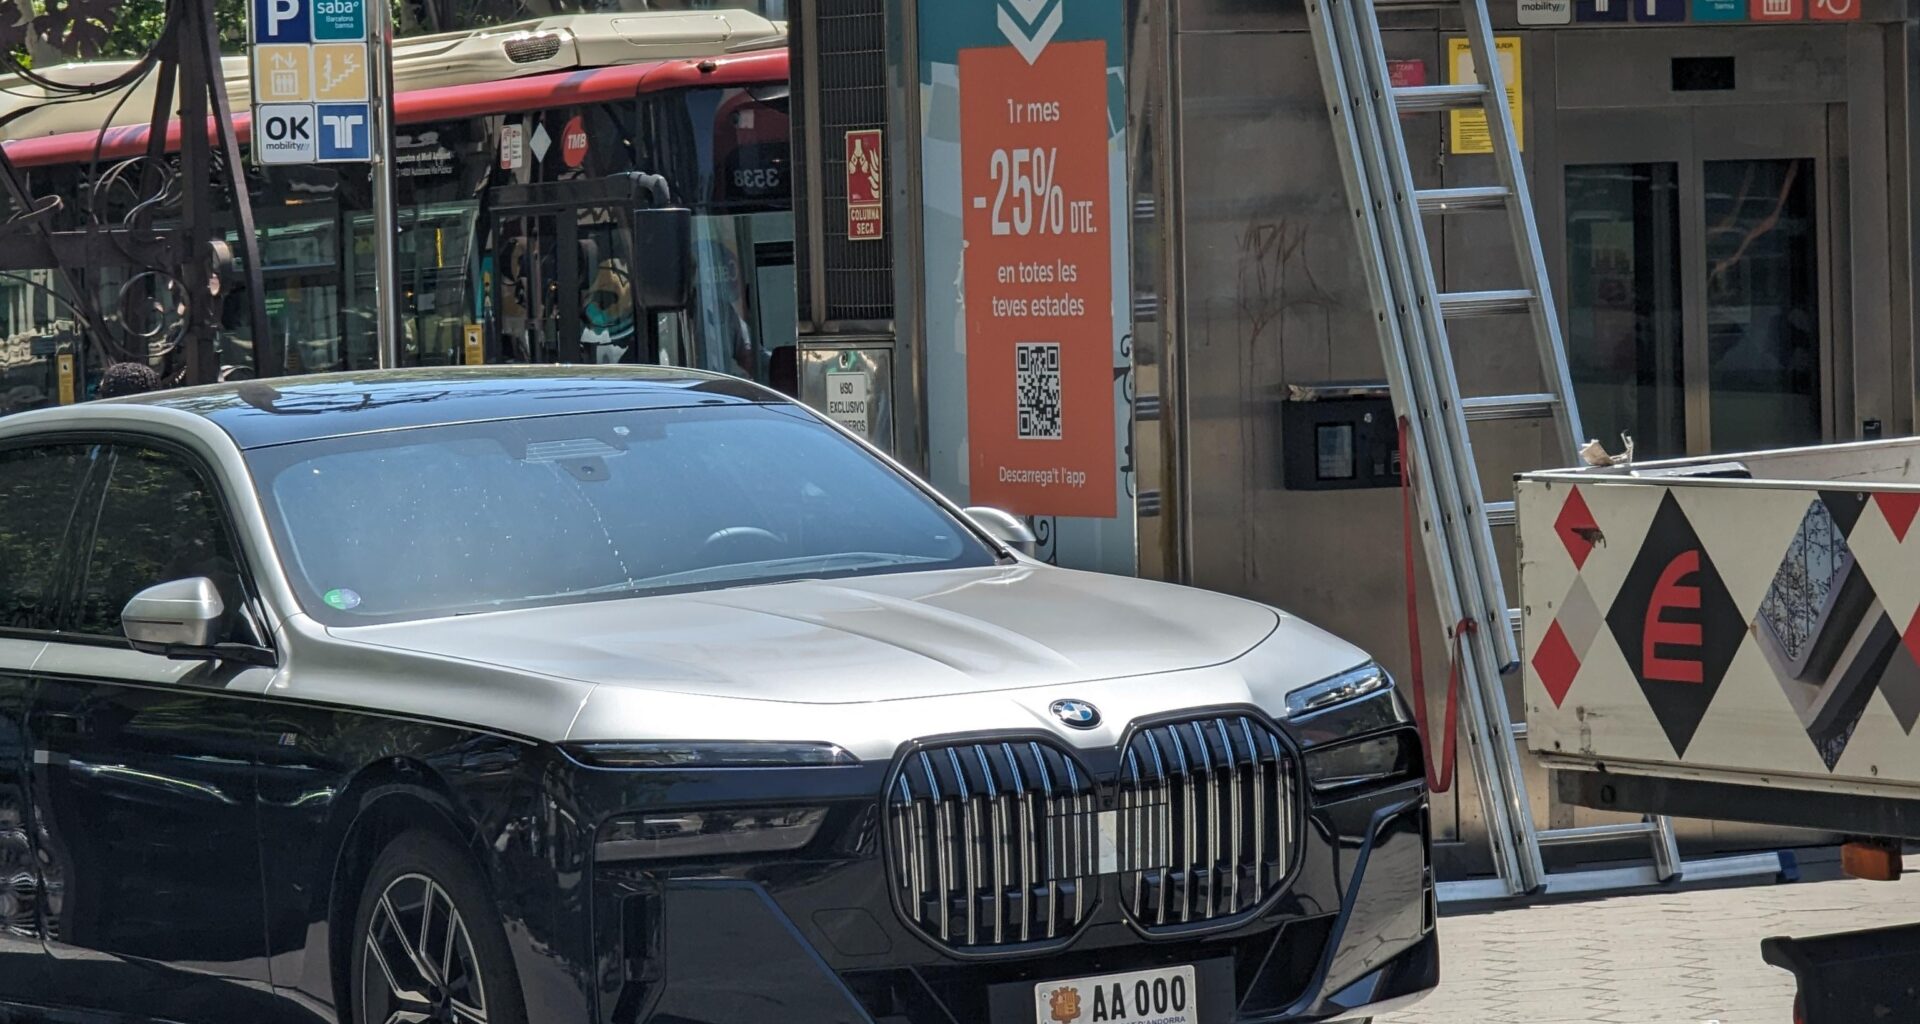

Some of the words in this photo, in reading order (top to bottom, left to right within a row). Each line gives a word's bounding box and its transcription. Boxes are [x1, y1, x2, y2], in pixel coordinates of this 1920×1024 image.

[267, 0, 300, 36] P
[326, 15, 354, 23] Barcelona
[1008, 99, 1023, 124] 1r
[1027, 101, 1060, 123] mes
[265, 116, 310, 141] OK
[567, 133, 587, 149] TMB
[973, 147, 1064, 236] -25%
[1070, 201, 1097, 234] DTE.
[851, 207, 880, 221] COLUMNA
[856, 222, 874, 235] SECA
[998, 266, 1015, 283] en
[1019, 261, 1054, 283] totes
[1058, 258, 1077, 282] les
[992, 295, 1027, 317] teves
[1031, 292, 1085, 317] estades
[830, 401, 865, 413] EXCLUSIVO
[999, 466, 1059, 487] Descarrega't
[1061, 466, 1086, 488] l'app
[1092, 982, 1127, 1023] AA
[1134, 975, 1186, 1017] 000
